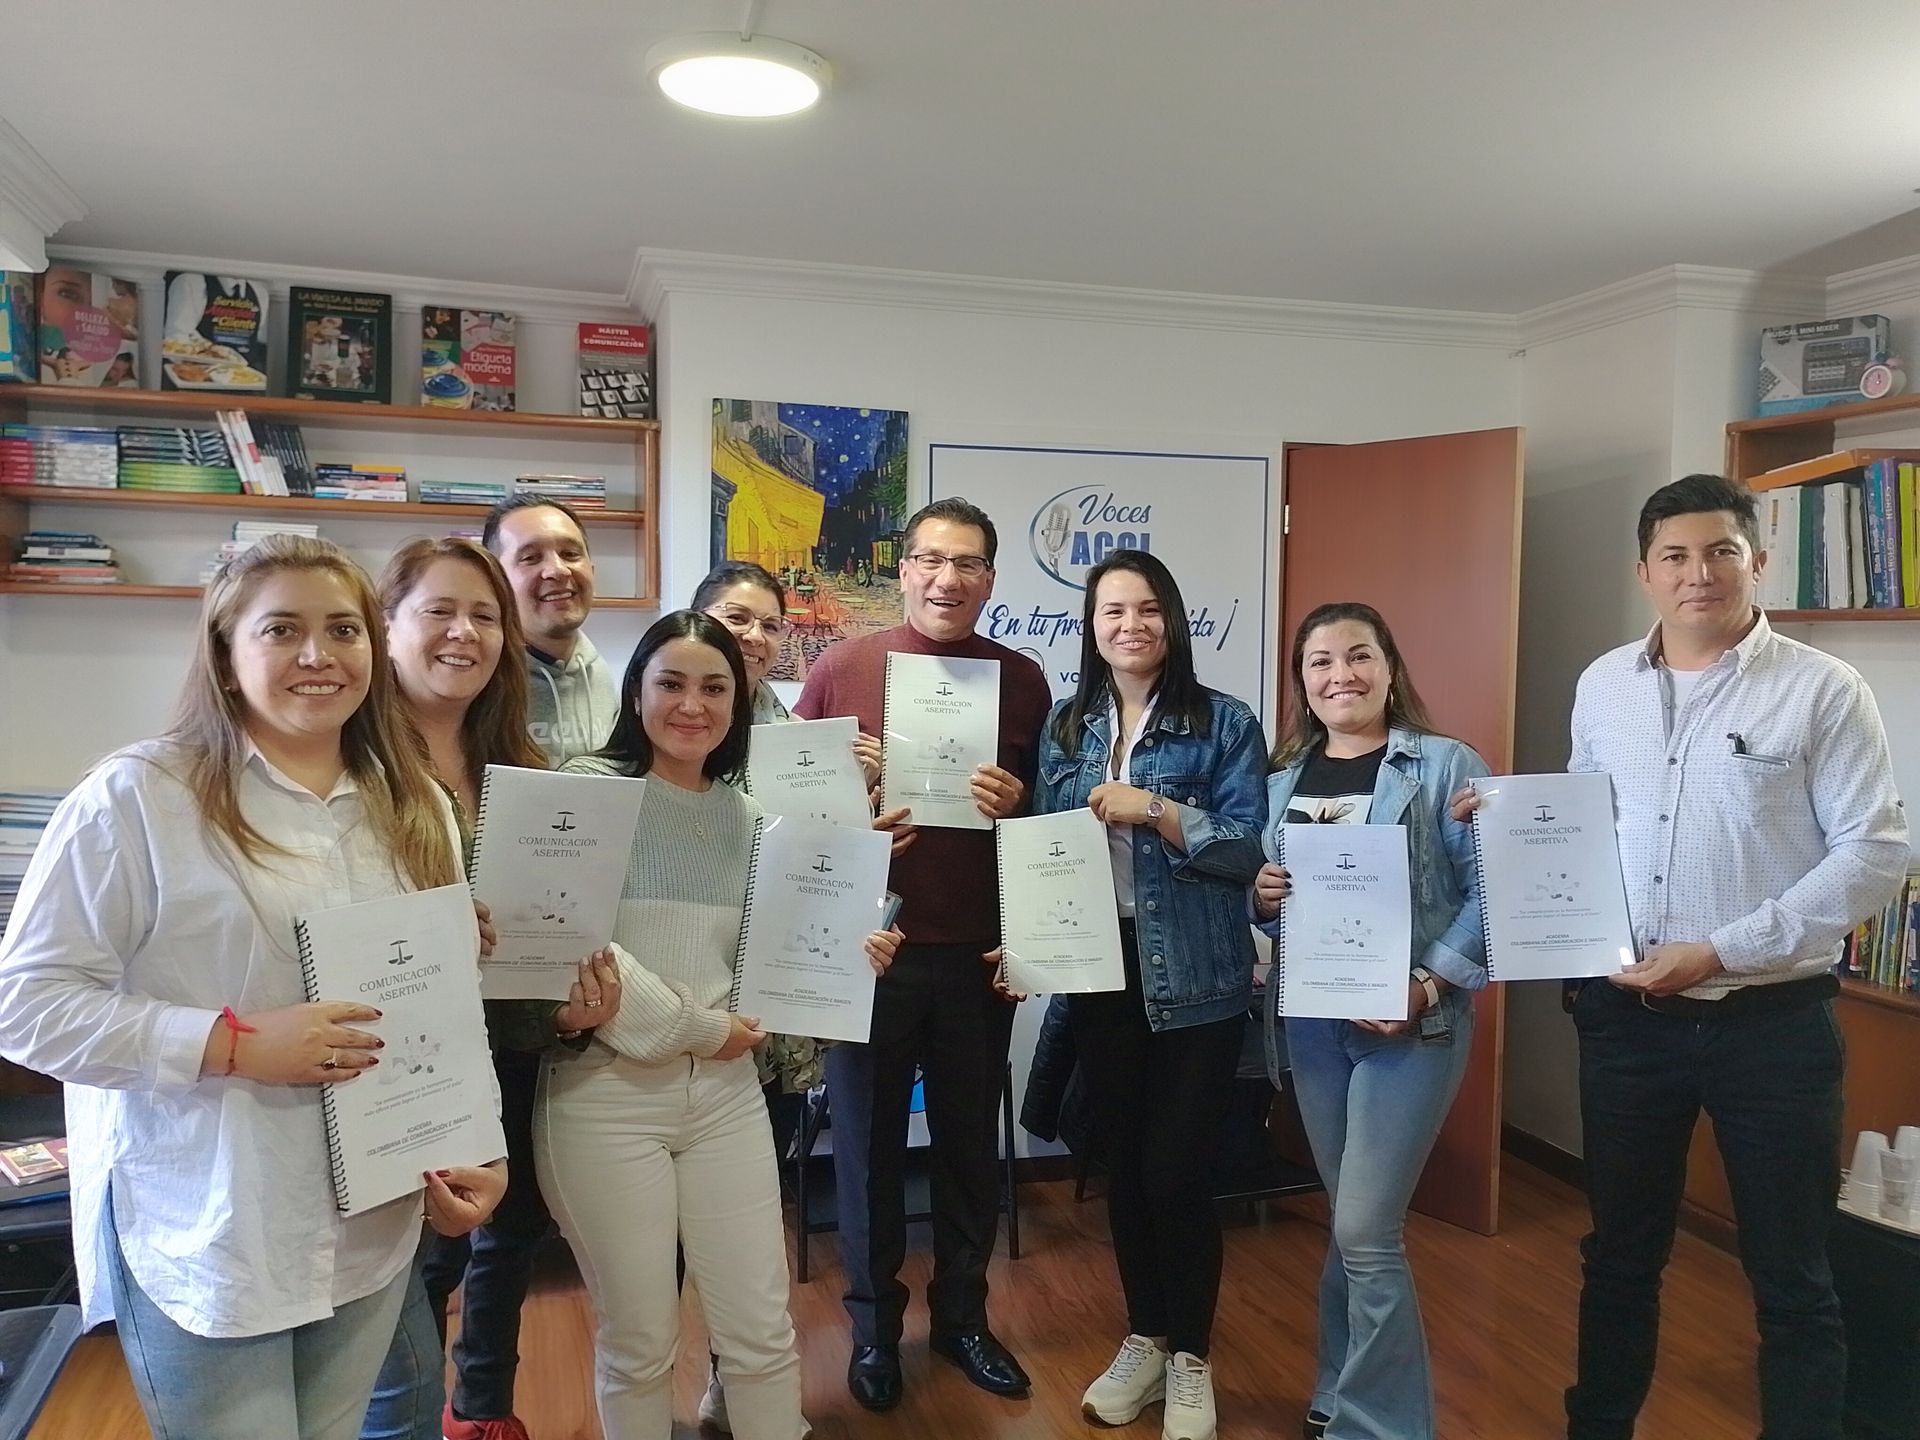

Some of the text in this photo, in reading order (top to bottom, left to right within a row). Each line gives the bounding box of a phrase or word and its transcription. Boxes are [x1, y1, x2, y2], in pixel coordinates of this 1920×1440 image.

[75, 311, 110, 325] BELLEZA
[598, 327, 630, 336] MÁSTER
[1816, 324, 1839, 332] MIXER
[583, 338, 645, 349] COMUNICACIÓN
[471, 351, 512, 366] Etiqueta
[463, 362, 512, 375] moderna
[1078, 492, 1152, 525] Voces
[987, 604, 1022, 639] En
[913, 698, 973, 707] COMUNICACIÓN
[924, 706, 961, 716] ASERTIVA
[775, 768, 838, 781] COMUNICACIÓN
[790, 779, 828, 789] ASERTIVA
[1508, 825, 1582, 836] COMUNICACIÓN
[518, 835, 599, 848] COMUNICACIÓN
[1523, 836, 1569, 846] ASERTIVA
[532, 848, 582, 858] ASERTIVA
[1027, 858, 1086, 871] COMUNICACIÓN
[1039, 868, 1076, 878] ASERTIVA
[1312, 874, 1379, 882] COMUNICACIÓN
[785, 872, 855, 890] COMUNICACIÓN
[796, 885, 840, 898] ASERTIVA
[1325, 883, 1366, 892] ASERTIVA
[359, 963, 442, 993] COMUNICACIÓN
[377, 981, 429, 1003] ASERTIVA
